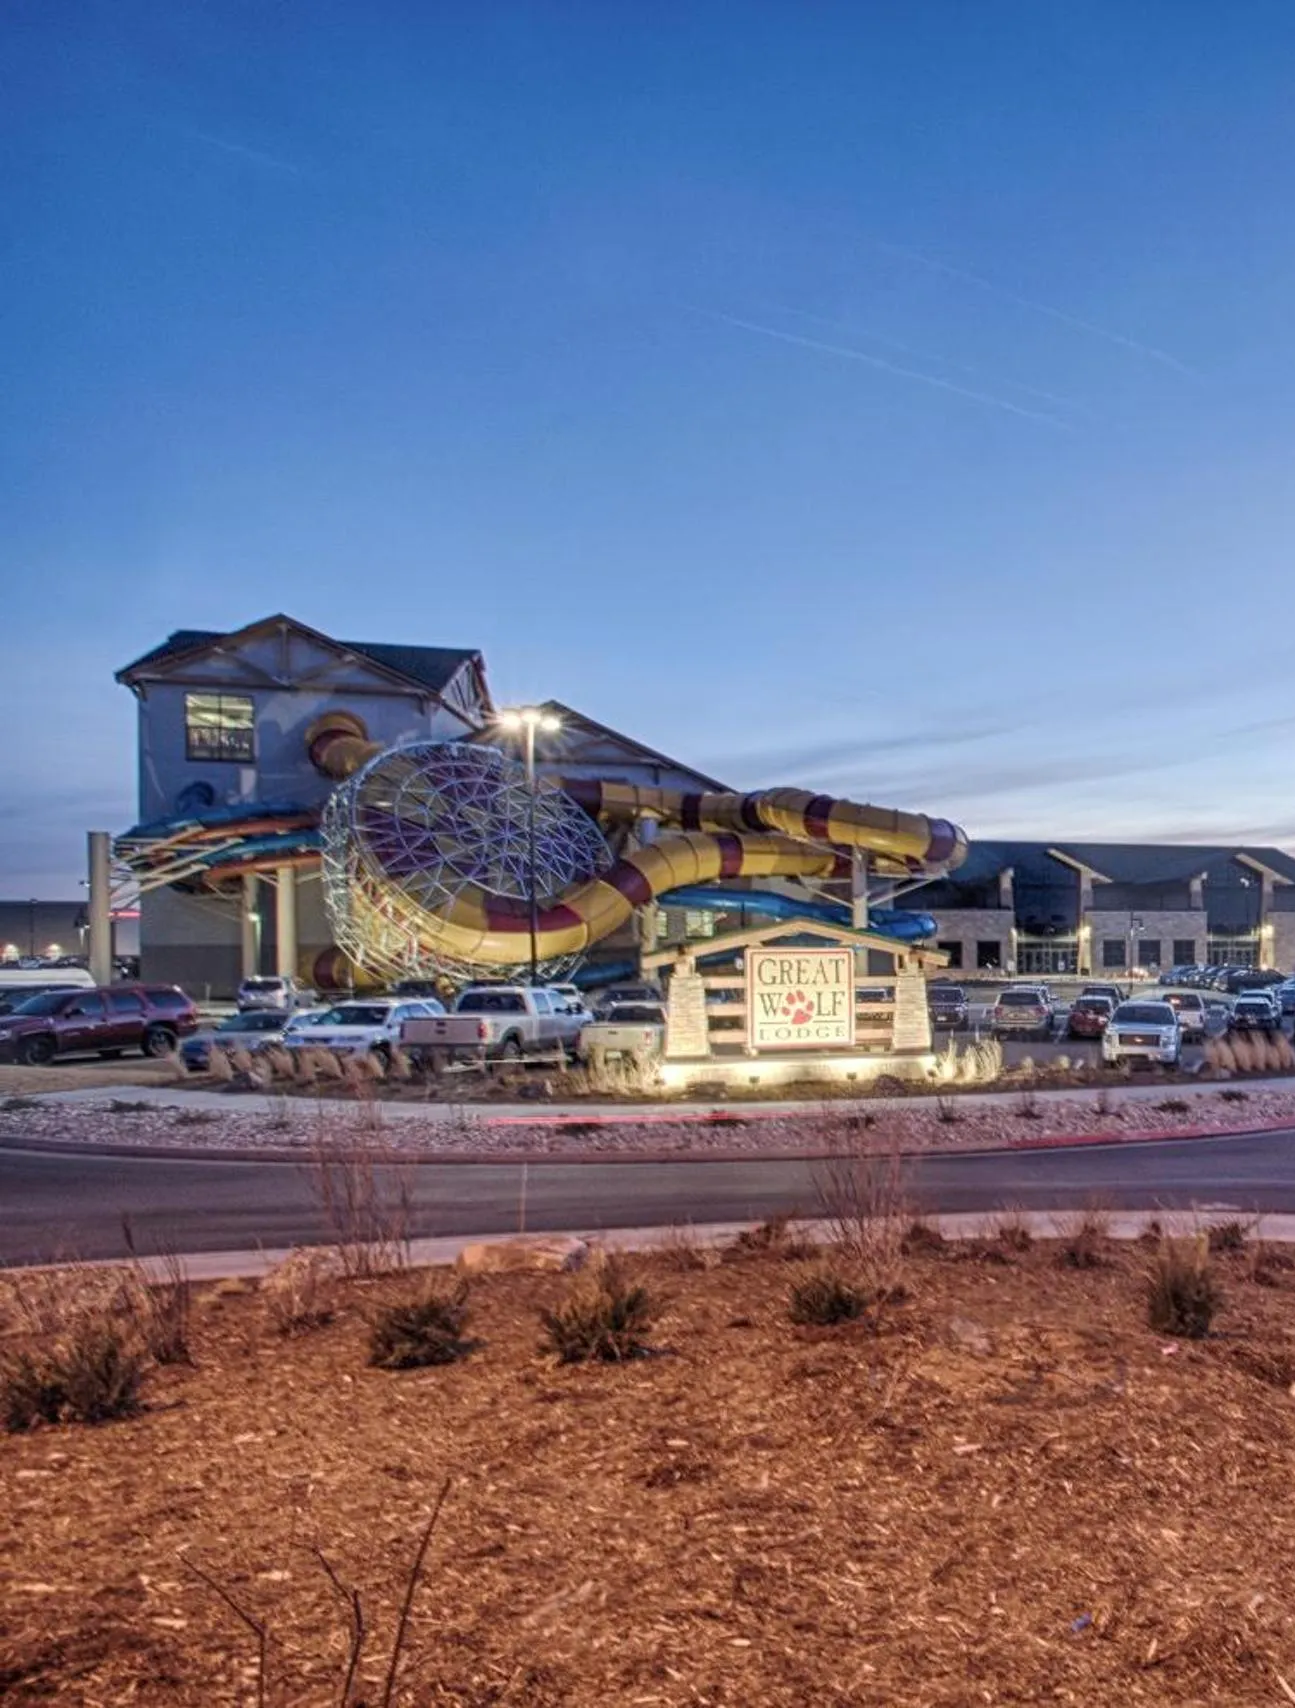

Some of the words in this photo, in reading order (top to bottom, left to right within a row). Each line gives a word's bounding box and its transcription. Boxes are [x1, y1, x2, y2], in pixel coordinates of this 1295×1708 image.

[757, 957, 845, 986] GREAT
[757, 989, 846, 1025] WLF
[759, 1026, 845, 1041] LODGE
